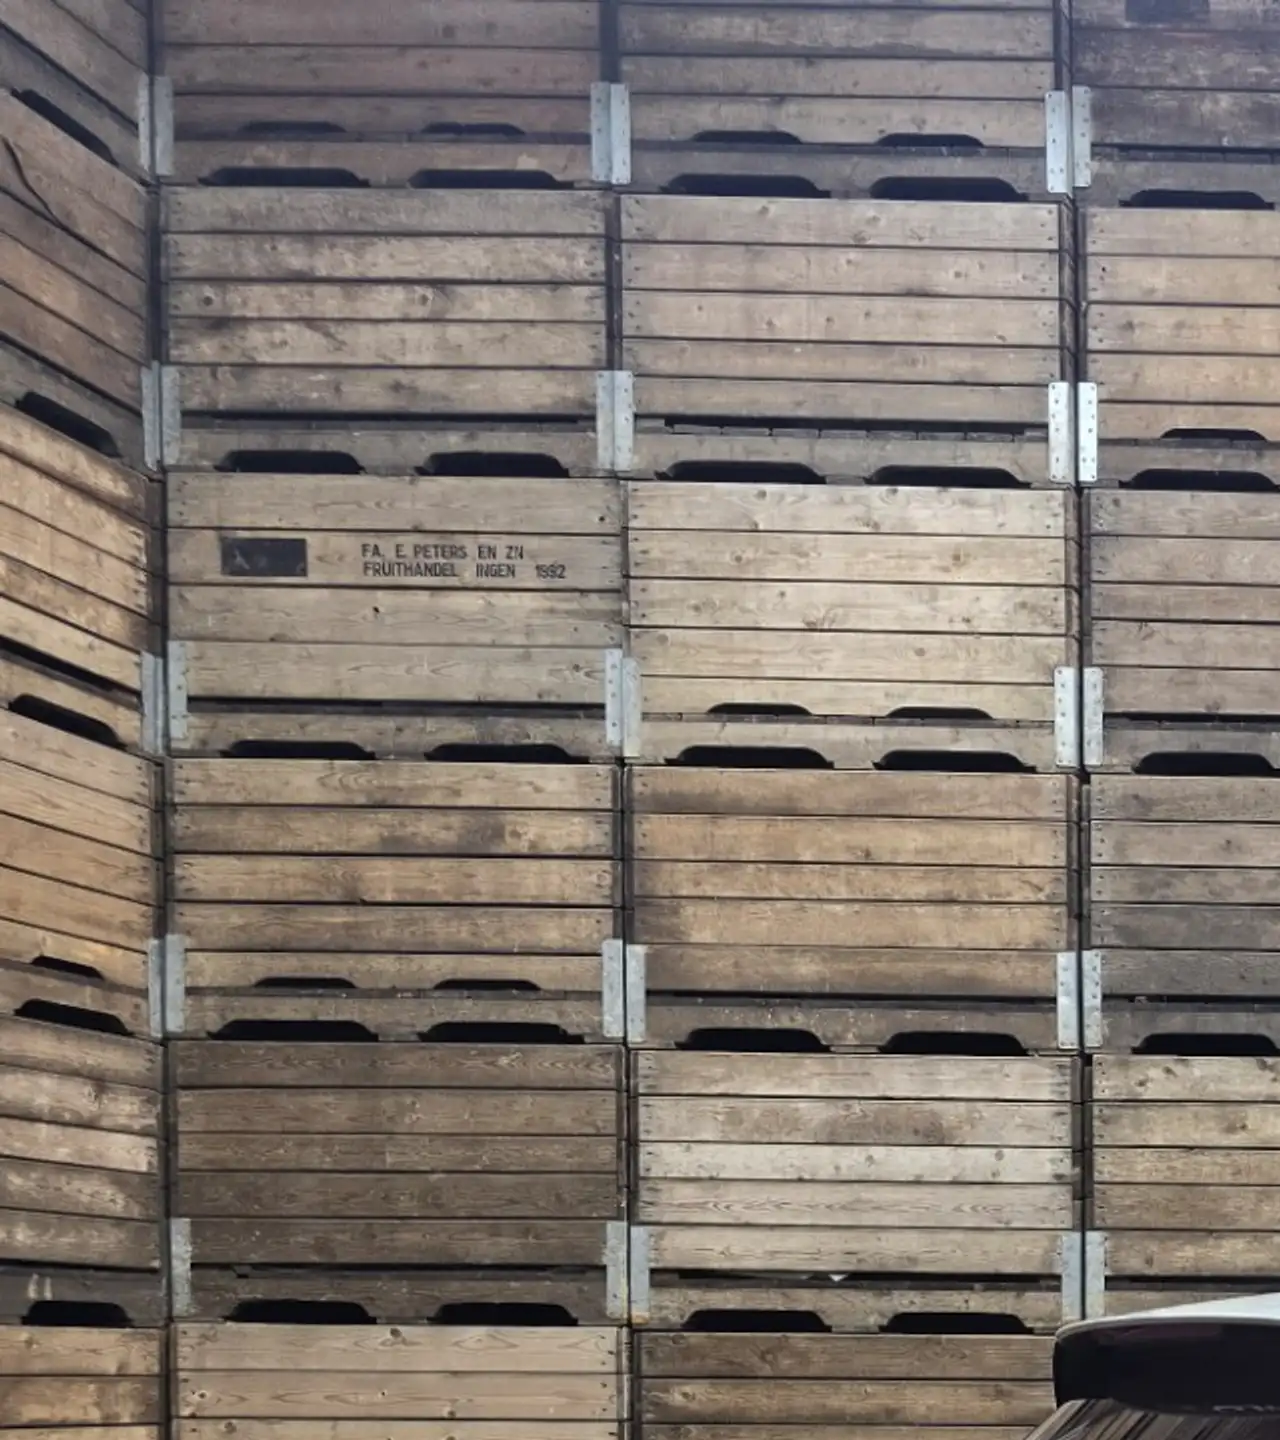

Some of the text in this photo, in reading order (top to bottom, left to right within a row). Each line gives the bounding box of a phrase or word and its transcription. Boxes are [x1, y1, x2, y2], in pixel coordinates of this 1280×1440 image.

[414, 545, 468, 560] PETERS
[478, 545, 497, 560] EN
[506, 545, 524, 560] ZN
[363, 562, 566, 579] FRUITHANDEL INGEN 1992
